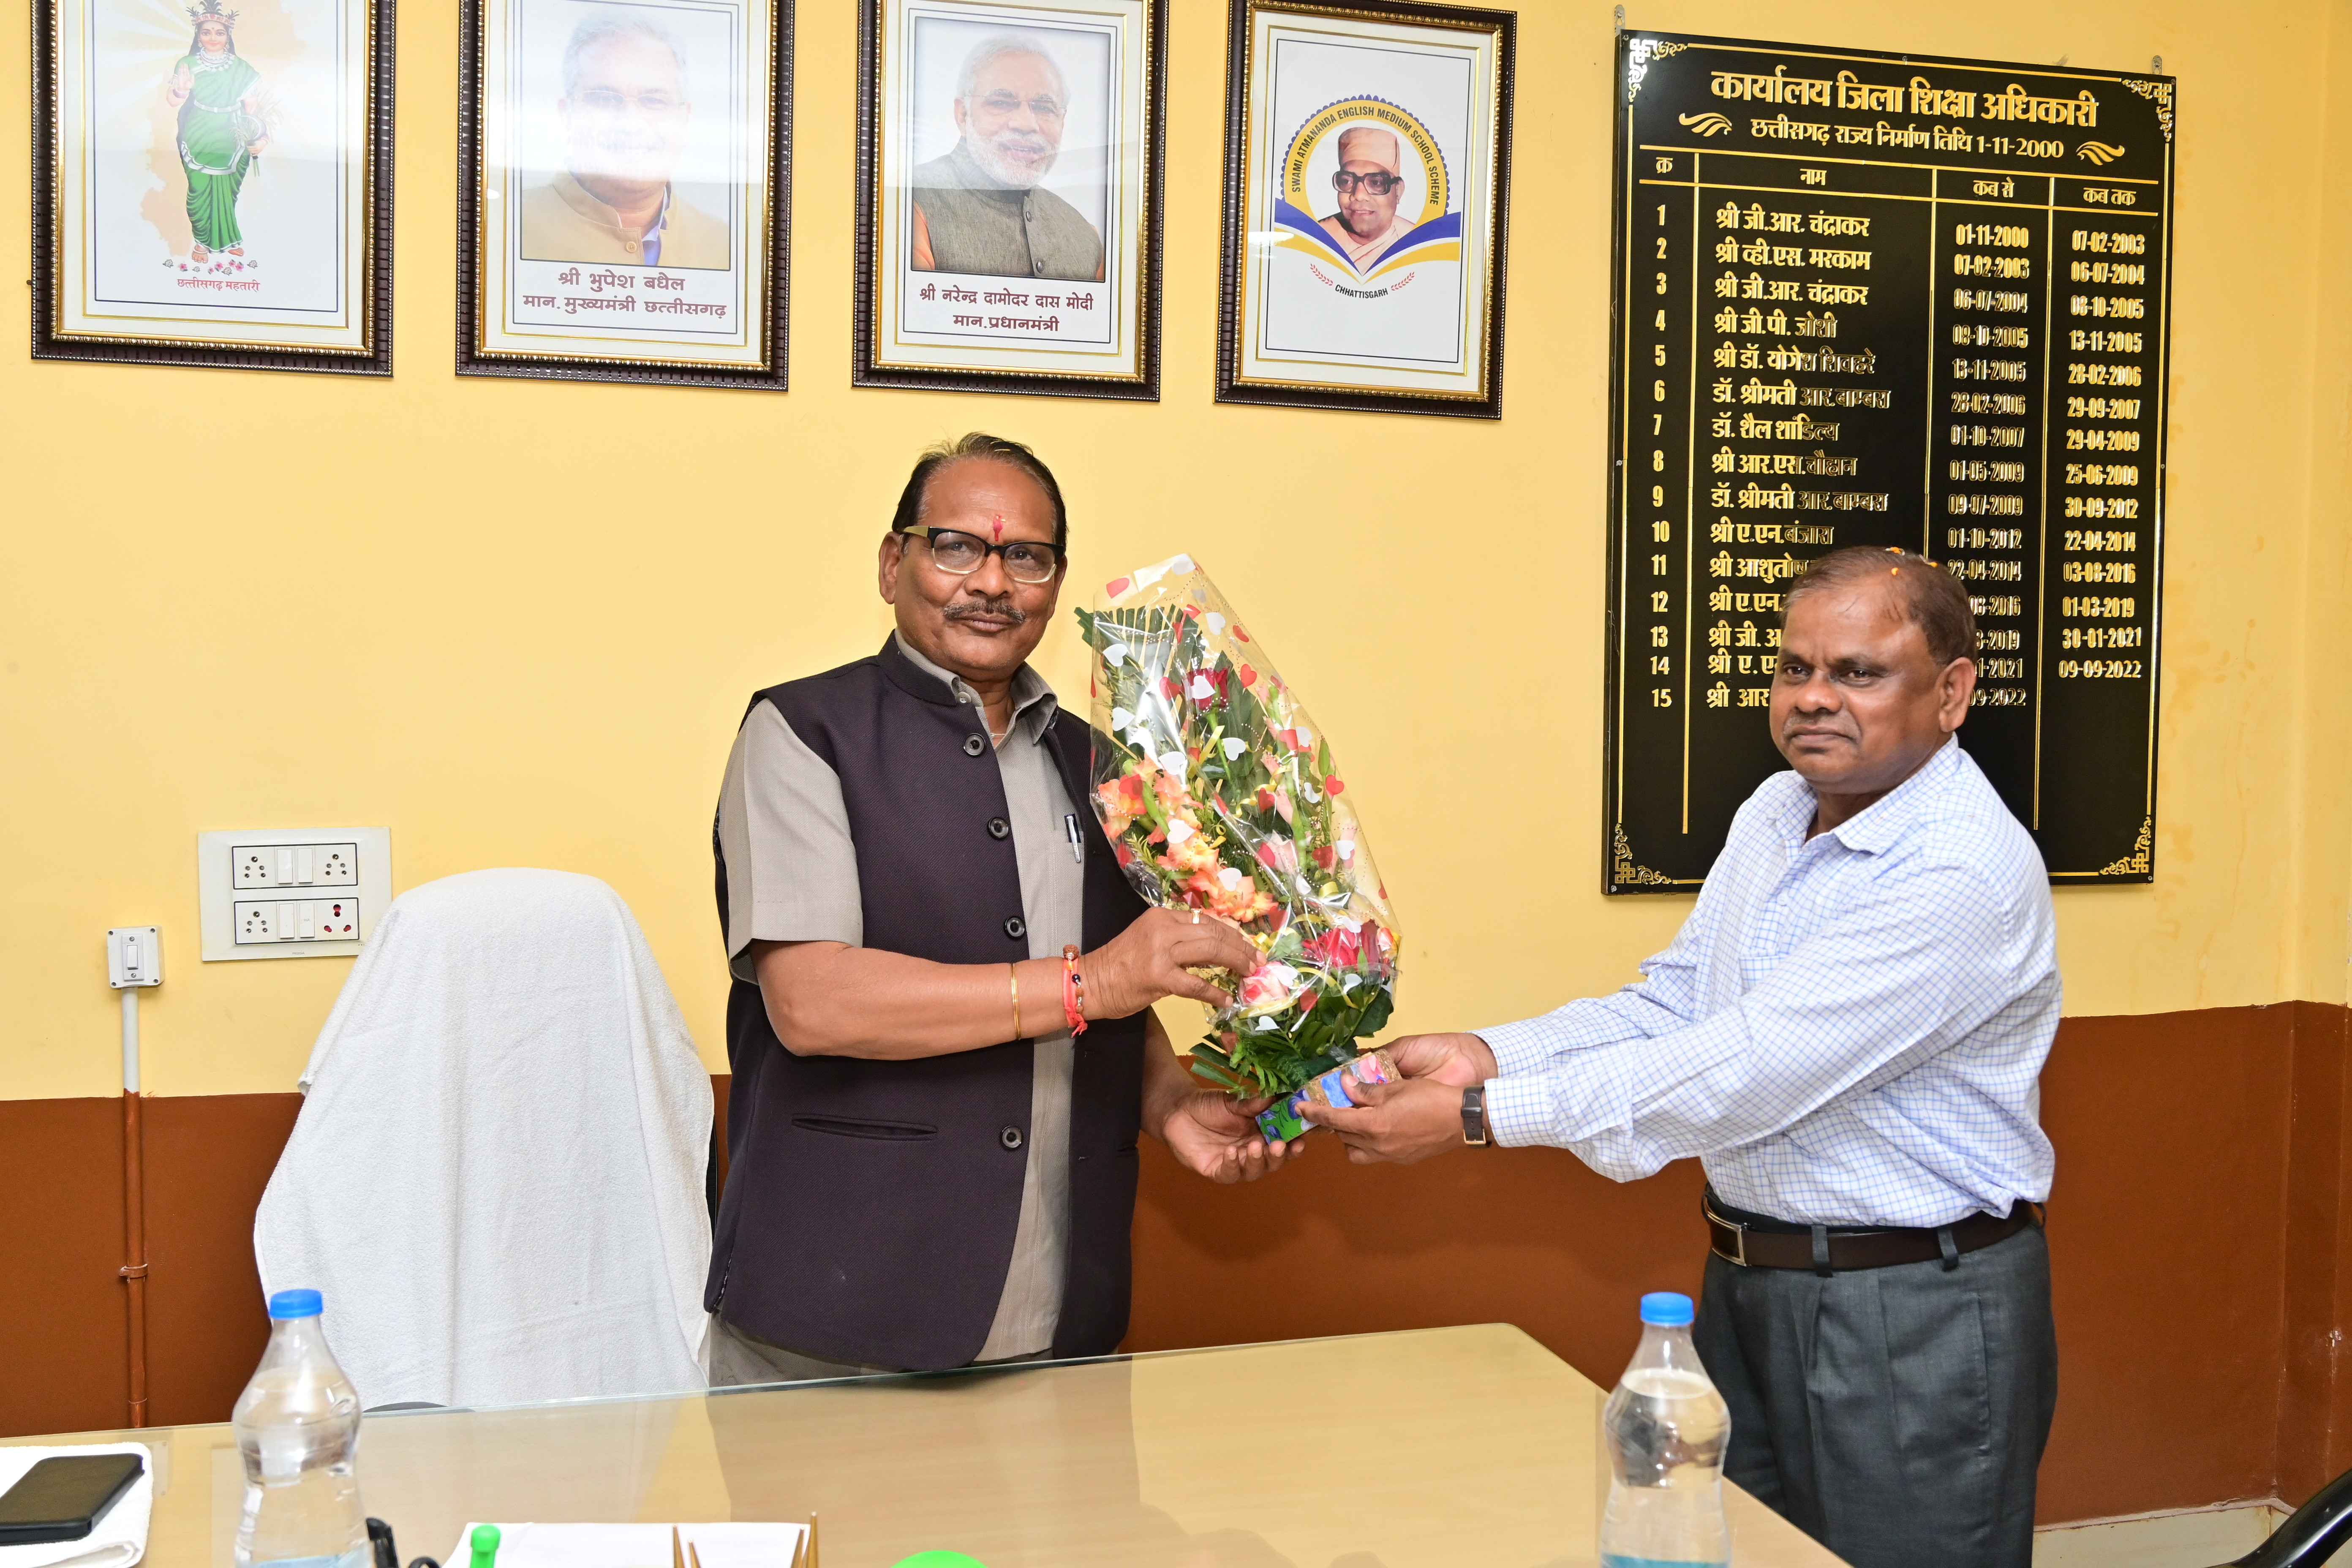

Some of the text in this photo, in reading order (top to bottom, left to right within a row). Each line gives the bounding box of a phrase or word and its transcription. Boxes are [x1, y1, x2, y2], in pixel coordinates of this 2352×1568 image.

[1711, 65, 2099, 128] कार्यालय जिला शिक्षा अधिकारी
[1751, 113, 2064, 158] छत्तीसगढ़ राज्य निर्माण तिथि 1-11-2000
[1292, 106, 1440, 206] SWAMI ATMANANDA ENGLISH MEDIUM SCHOOL SCHEME
[1656, 157, 1673, 174] क्र
[1800, 169, 1827, 185] नाम
[1973, 176, 2014, 198] कब से
[2083, 187, 2137, 206] कब तक
[1657, 204, 1666, 226] 1
[1716, 201, 1870, 237] श्री जी.आर. चंद्राकर
[1955, 223, 2029, 248] 01-11-2000
[2072, 230, 2145, 255] 07-02-2003
[1656, 237, 1667, 259] 2
[1715, 235, 1871, 270] श्री व्ही.एस. मरकाम
[558, 267, 580, 285] श्री
[1954, 254, 2030, 279] 07-02-2003
[2071, 261, 2145, 285] 06-07-2004
[177, 277, 261, 292] छत्तीसगढ़ महतारी
[1335, 284, 1388, 299] CHHATTISGARH
[1656, 272, 1666, 295] 3
[1715, 270, 1869, 305] श्री जी.आर. चंद्राकर
[920, 283, 1093, 310] श्री नरेन्द्र दामोदर दास मोदी
[1954, 288, 2028, 313] 06-07-2004
[2070, 295, 2144, 319] 08-10-2005
[644, 298, 727, 319] छत्तीसगढ़
[1655, 310, 1666, 331] 4
[1714, 306, 1838, 338] श्री जी.पी. जोशी
[1952, 324, 2028, 348] 08-10-2005
[2069, 330, 2142, 353] 13-11-2005
[1655, 345, 1665, 366] 5
[1714, 340, 1876, 374] श्री डॉ. योगेश शिवहरे
[1952, 358, 2026, 382] 13-11-2005
[2068, 363, 2142, 387] 28-02-2006
[1654, 380, 1665, 402] 6
[1712, 377, 1736, 403] डॉ.
[1740, 377, 1797, 406] श्रीमती
[1951, 392, 2025, 415] 28-02-2006
[2067, 396, 2140, 419] 29-09-2007
[1653, 414, 1662, 436] 7
[1712, 411, 1735, 438] डॉ.
[1740, 412, 1773, 440] शैल
[1950, 425, 2025, 447] 01-10-2007
[2066, 429, 2140, 452] 29-04-2009
[1653, 450, 1663, 472] 8
[1711, 446, 1734, 474] श्री
[1949, 460, 2024, 482] 01-05-2009
[2066, 463, 2138, 486] 25-06-2009
[1652, 485, 1663, 507] 9
[1711, 482, 1734, 509] डॉ.
[1738, 482, 1795, 509] श्रीमती
[1948, 493, 2023, 516] 09-07-2009
[2065, 497, 2138, 519] 30-09-2012
[1652, 520, 1670, 542] 10
[1710, 516, 1734, 544] श्री
[1947, 527, 2022, 549] 01-10-2012
[2064, 530, 2136, 552] 22-04-2014
[1651, 554, 1667, 576] 11
[1709, 550, 1734, 578] श्री
[1947, 559, 2022, 581] 22-04-2014
[2063, 561, 2136, 583] 03-08-2016
[1650, 591, 1669, 612] 12
[1709, 584, 1732, 612] श्री
[1968, 595, 2021, 616] 08-2016
[2062, 596, 2135, 618] 01-03-2019
[1650, 626, 1668, 648] 13
[1708, 620, 1731, 648] श्री
[1734, 620, 1761, 647] जी.
[1976, 629, 2020, 650] 3-2019
[2062, 626, 2142, 649] 30-01-2021
[1650, 656, 1669, 675] 14
[1708, 648, 1731, 675] श्री
[1975, 657, 2023, 678] 1-2021
[2058, 660, 2142, 678] 09-09-2022
[1652, 689, 1672, 708] 15
[1706, 681, 1730, 709] श्री
[1968, 688, 2026, 706] 09-2022
